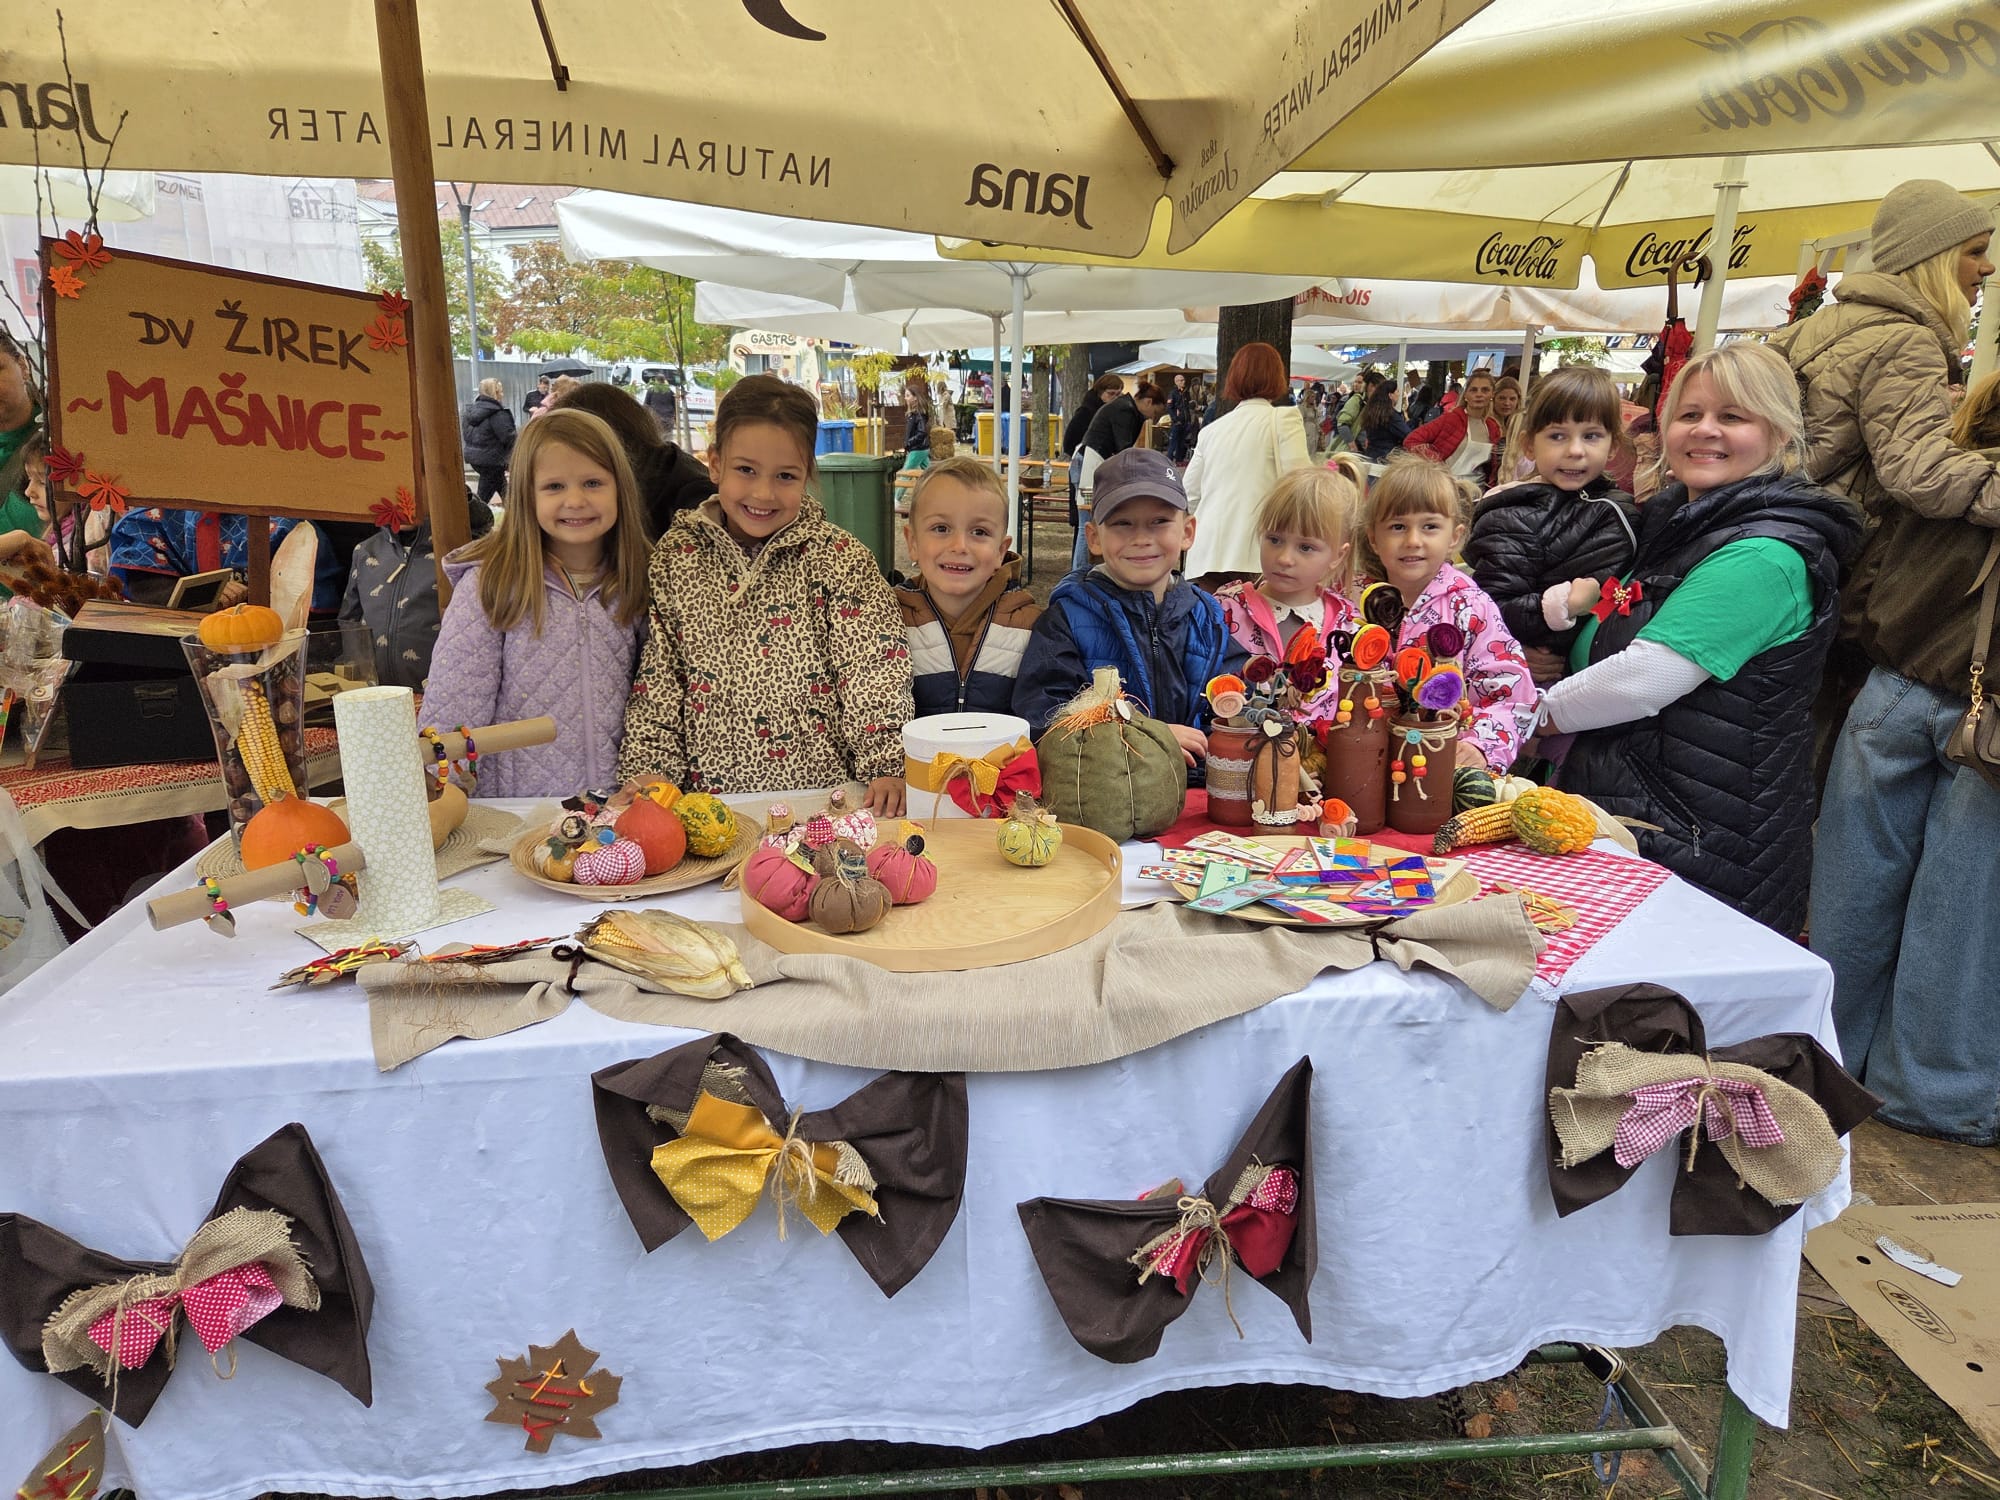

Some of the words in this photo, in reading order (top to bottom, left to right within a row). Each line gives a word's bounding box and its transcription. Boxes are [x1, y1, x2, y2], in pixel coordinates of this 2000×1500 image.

[1475, 231, 1568, 279] Coca-Cola
[128, 311, 195, 349] DV
[215, 299, 371, 375] ŽIREK
